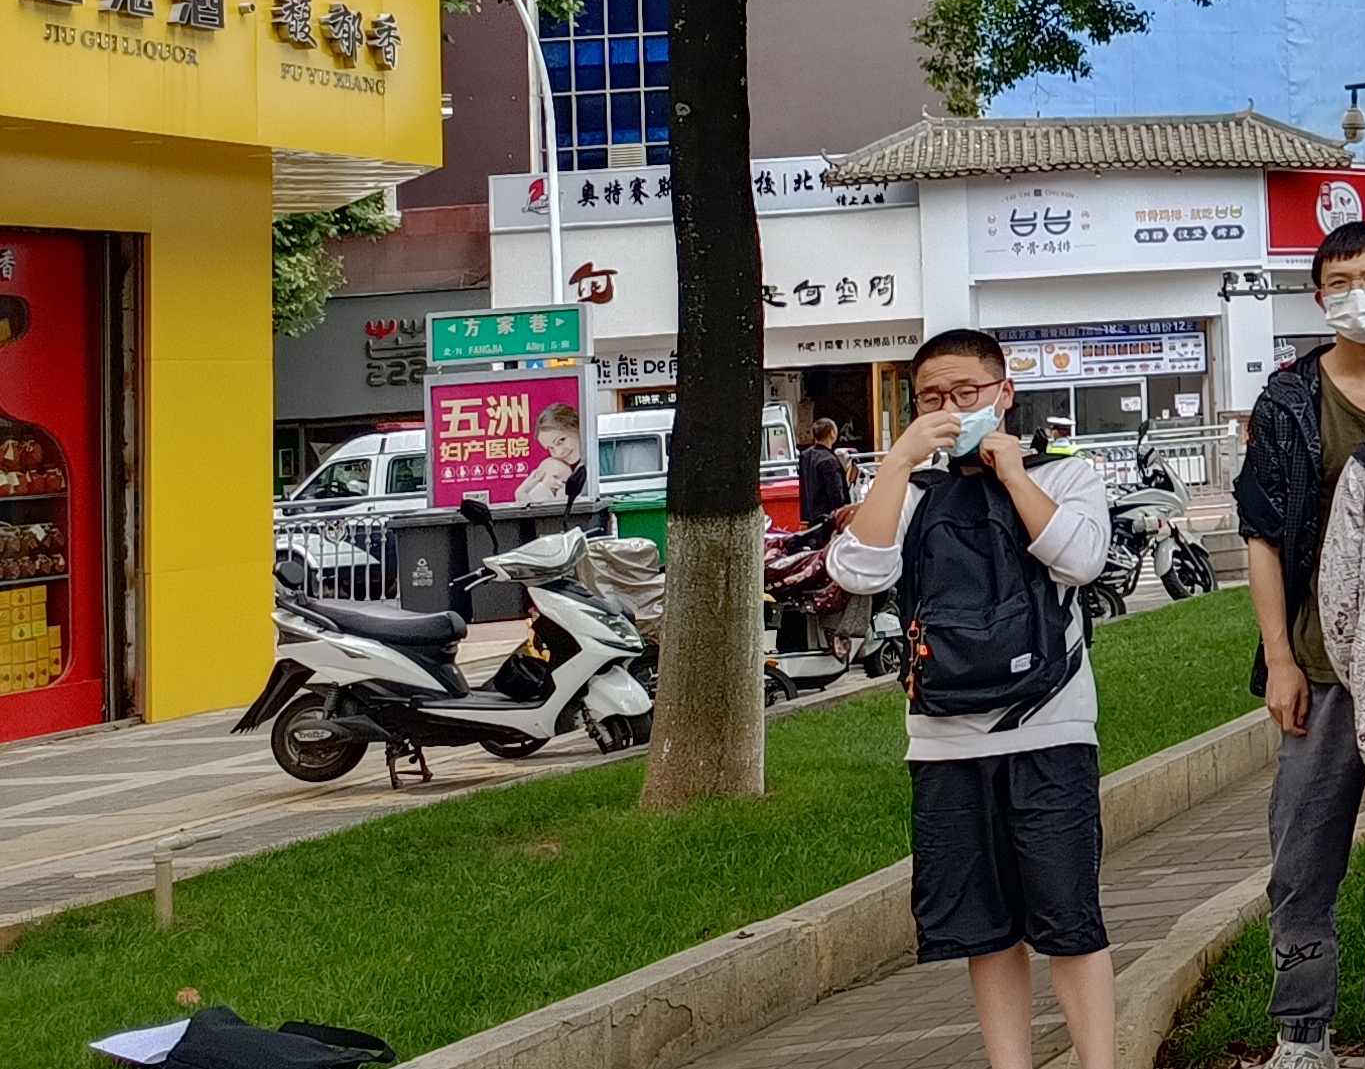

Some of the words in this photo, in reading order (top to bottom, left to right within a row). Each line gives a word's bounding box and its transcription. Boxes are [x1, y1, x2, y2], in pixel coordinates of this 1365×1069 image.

[43, 24, 76, 47] JIU
[80, 30, 118, 54] GUI
[122, 35, 199, 65] LIQUOR
[281, 63, 303, 82] FU
[306, 68, 330, 88] YU
[333, 73, 386, 96] XIANG
[463, 314, 549, 337] 方家巷
[469, 344, 504, 355] FANGJIA
[440, 394, 530, 438] 五洲
[439, 438, 530, 462] 妇产医院
